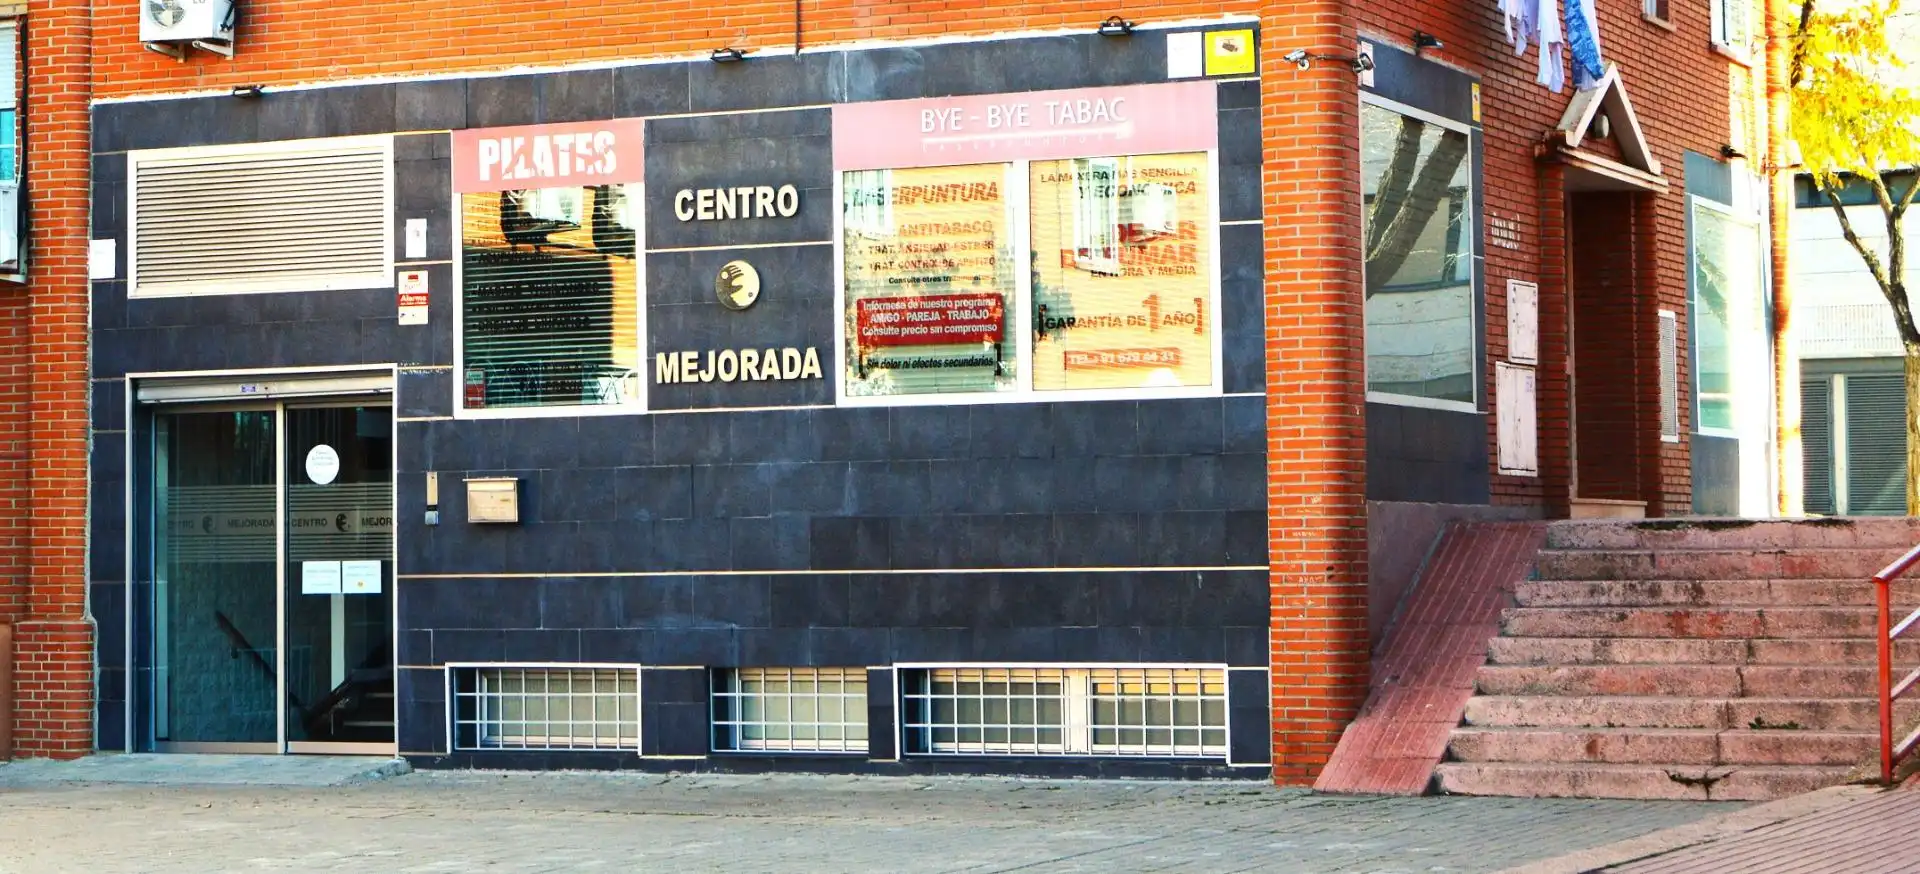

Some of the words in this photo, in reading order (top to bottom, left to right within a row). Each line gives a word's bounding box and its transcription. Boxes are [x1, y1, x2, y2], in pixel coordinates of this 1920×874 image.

[921, 107, 963, 133] BYE
[987, 104, 1030, 129] BYE
[1045, 97, 1126, 124] TABAC
[479, 131, 617, 181] PILATES
[674, 184, 799, 222] CENTRO
[1158, 265, 1197, 276] MEDIA
[920, 299, 952, 309] nuestro
[1045, 312, 1124, 329] GARANTÍA
[1127, 314, 1148, 327] DE
[1142, 294, 1161, 331] 1
[1162, 311, 1196, 326] AÑO
[870, 312, 900, 323] AMIGO
[907, 311, 941, 321] PAREJA
[947, 309, 989, 320] TRABAJO
[862, 326, 900, 336] Consulte
[901, 325, 928, 337] precio
[930, 326, 942, 334] sin
[944, 323, 998, 335] compromiso
[656, 347, 823, 384] MEJORADA
[867, 358, 881, 370] Sin
[902, 357, 912, 369] ni
[912, 356, 943, 368] efectos
[944, 353, 994, 368] secundarios
[227, 518, 275, 529] MEJORADA
[291, 518, 328, 528] CENTRO
